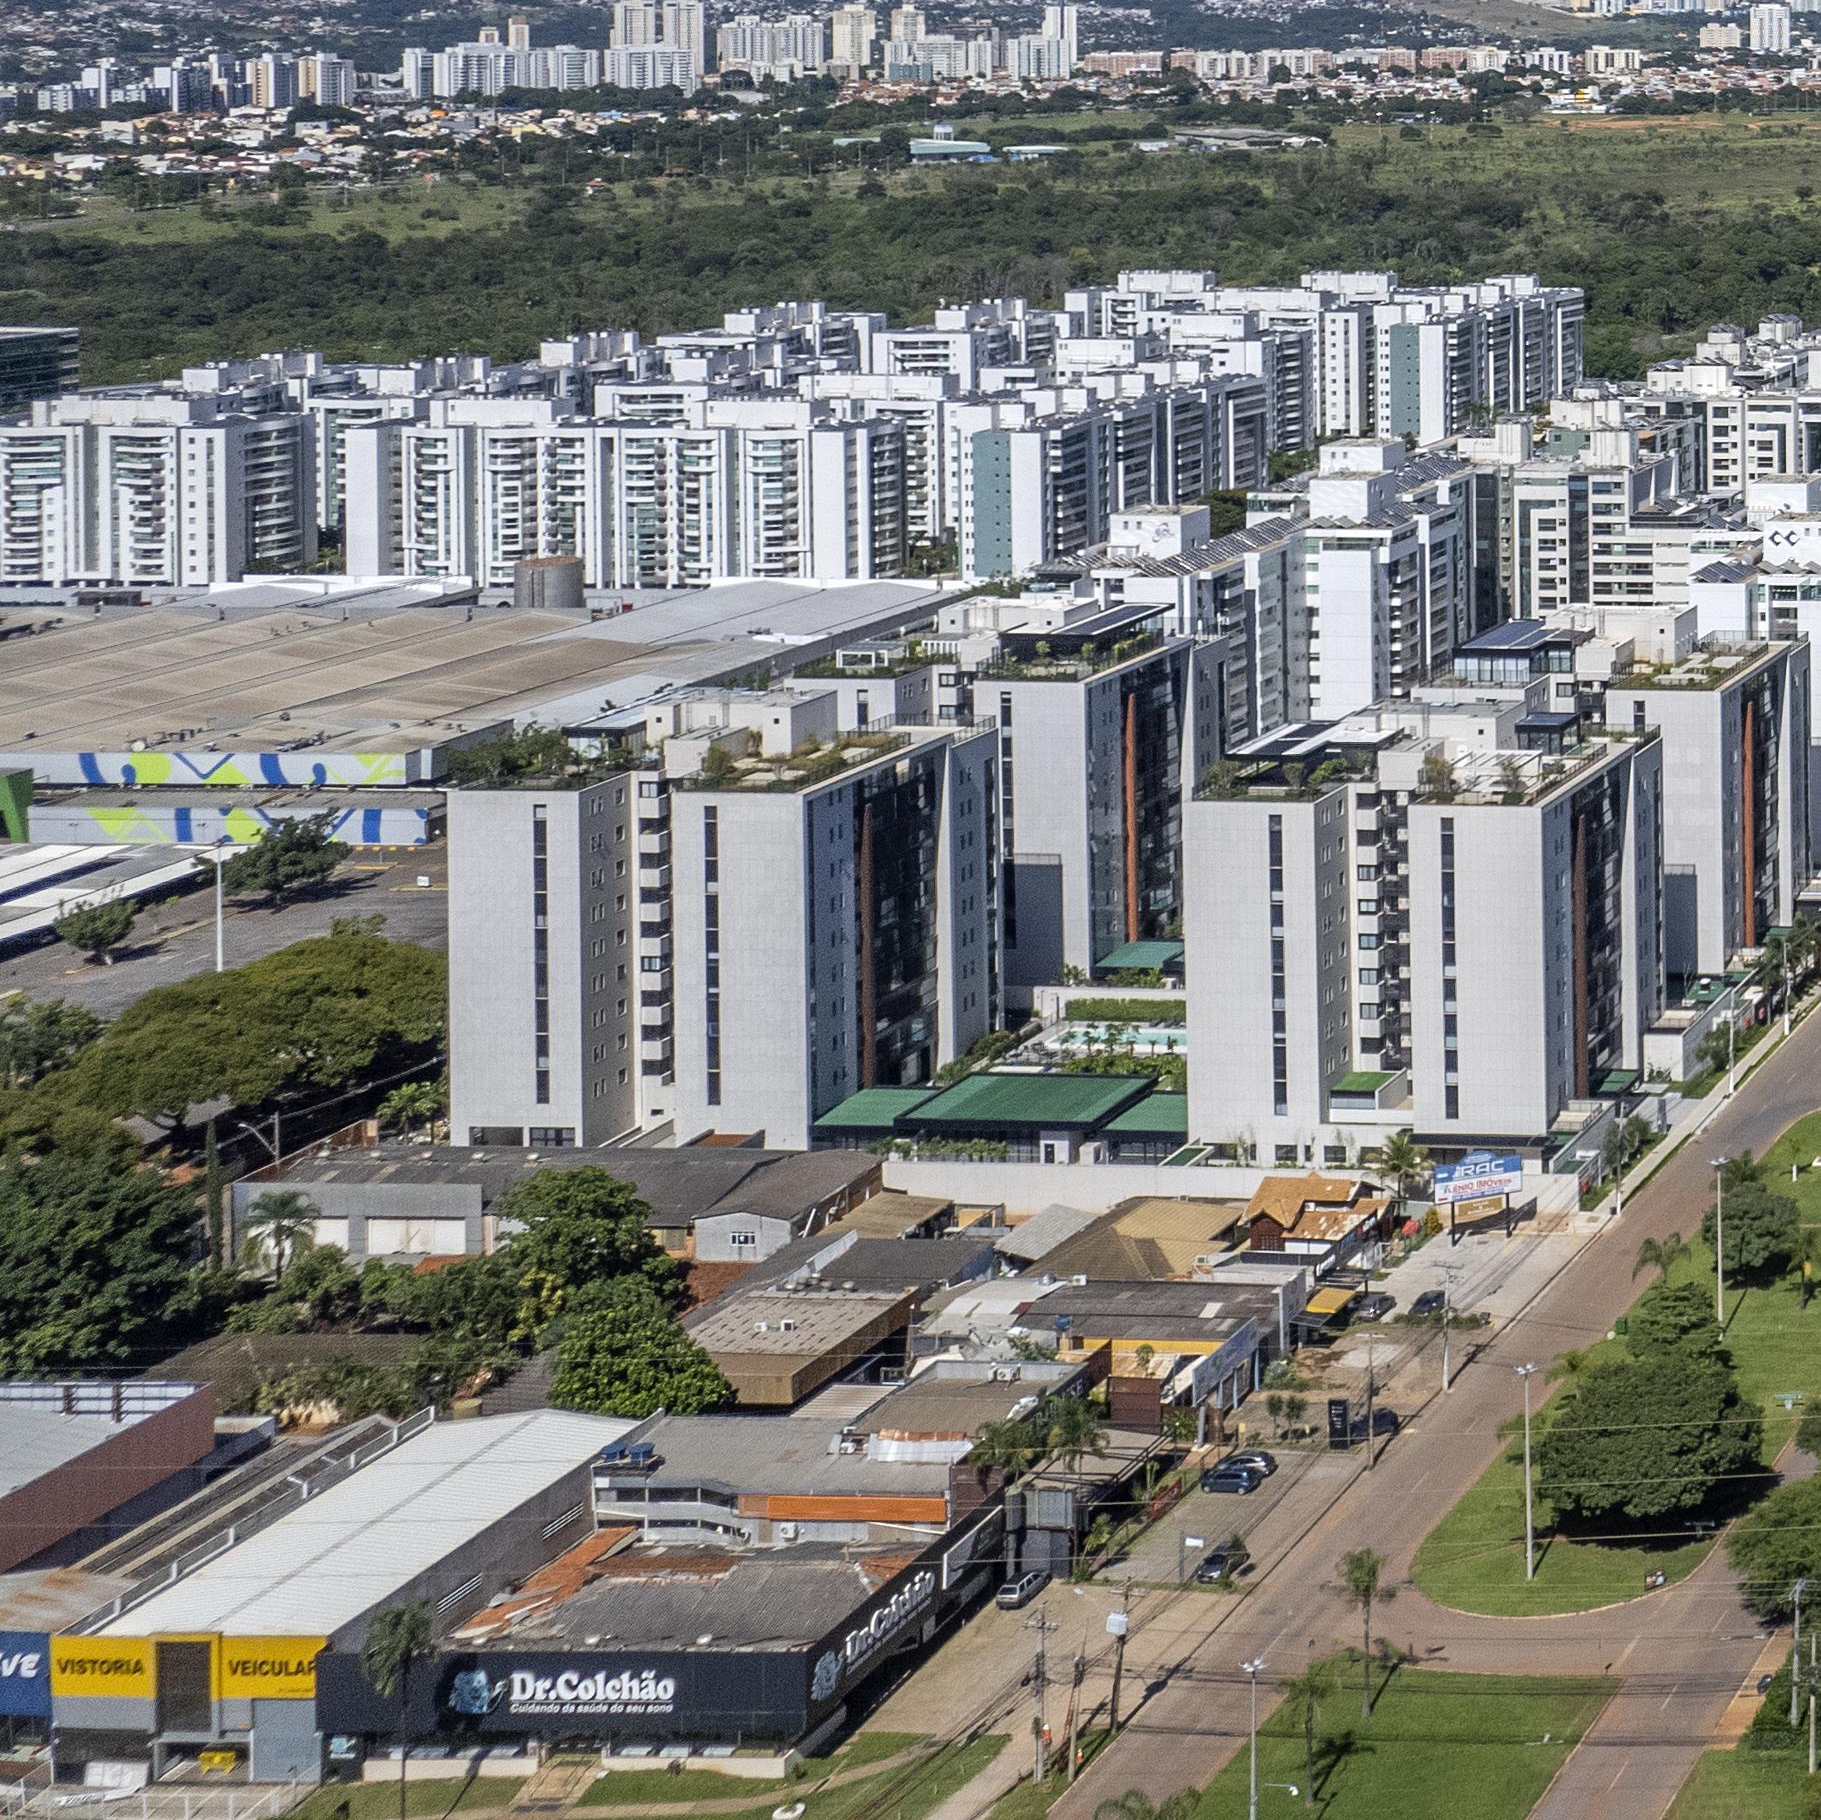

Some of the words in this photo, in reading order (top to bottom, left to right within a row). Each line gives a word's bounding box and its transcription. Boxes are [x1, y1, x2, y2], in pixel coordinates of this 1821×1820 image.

[55, 1658, 145, 1677] VISTORIA
[510, 1669, 676, 1701] Dr.Colchão
[510, 1703, 560, 1714] Cuidando
[562, 1703, 575, 1714] da
[610, 1703, 624, 1714] do
[626, 1704, 645, 1714] seu
